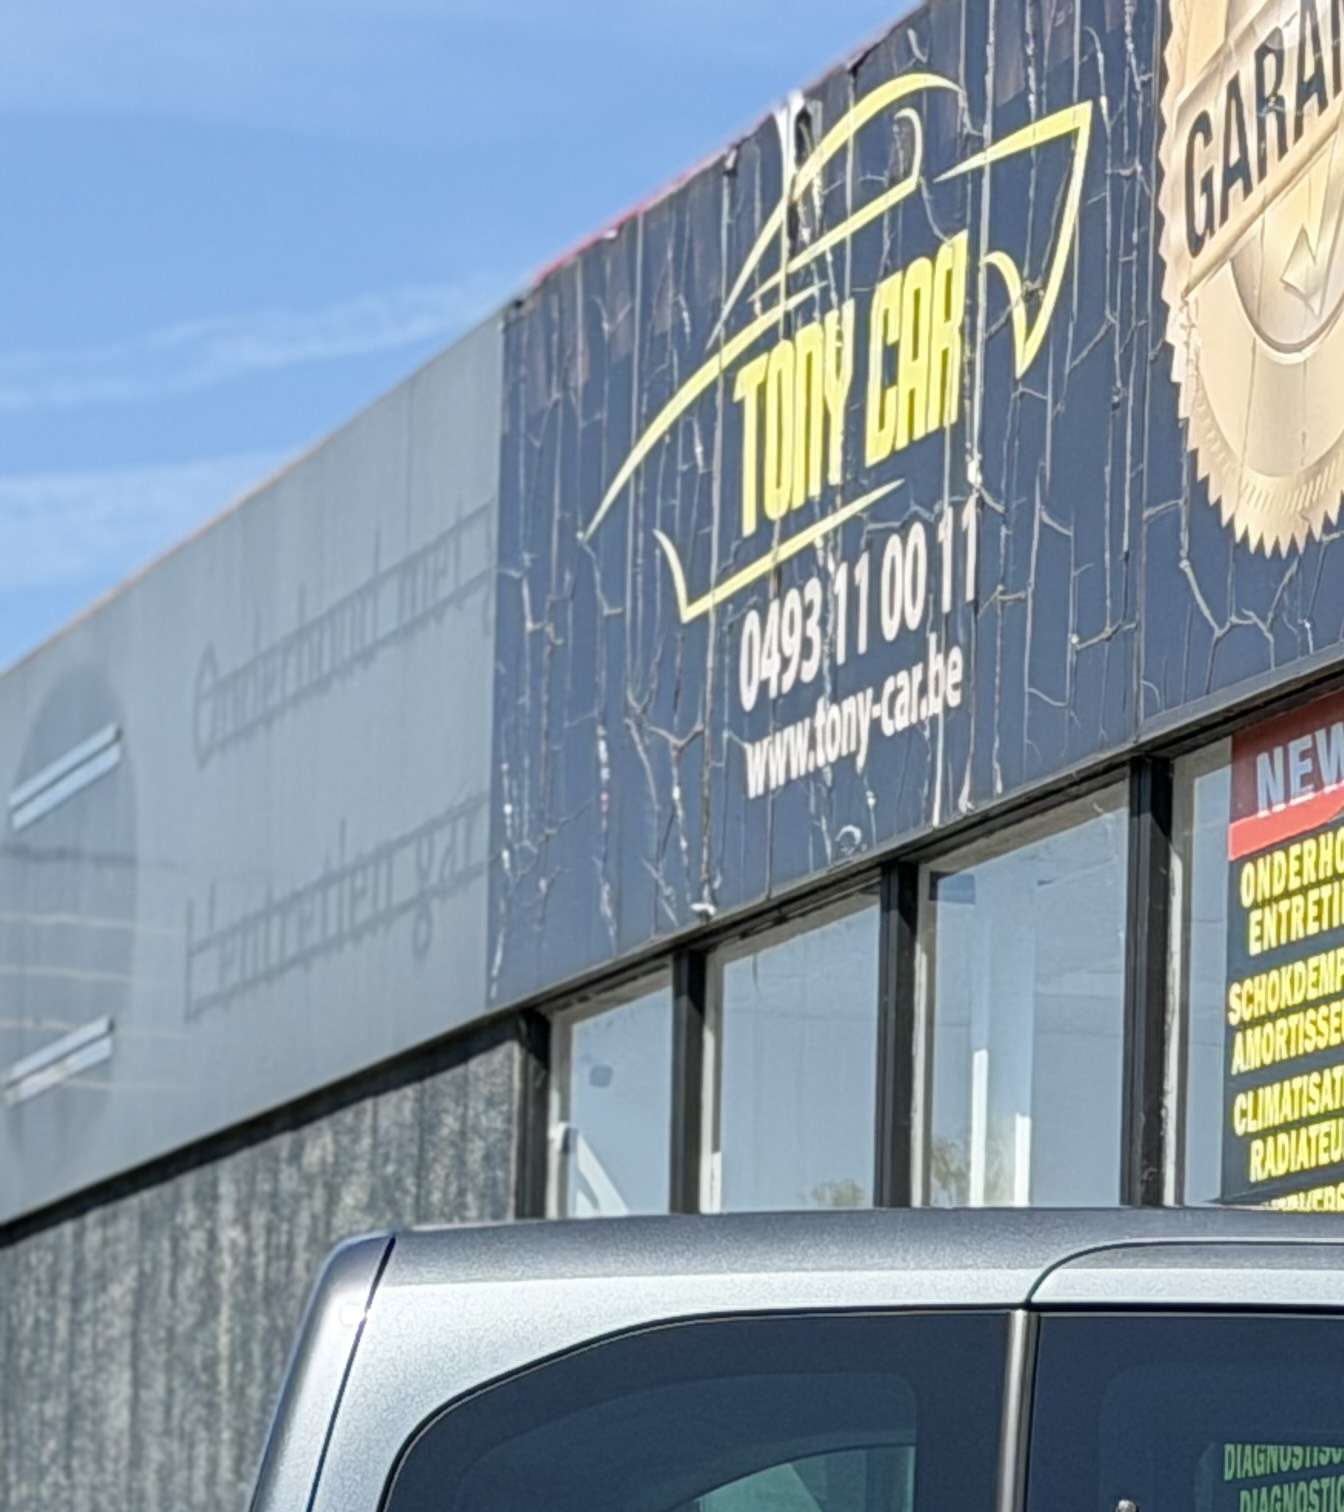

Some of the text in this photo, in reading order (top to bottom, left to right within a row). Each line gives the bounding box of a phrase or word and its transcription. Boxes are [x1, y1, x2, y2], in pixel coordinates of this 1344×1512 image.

[734, 229, 968, 537] TONY CAR
[739, 501, 980, 712] 0493 11 00 11
[744, 632, 963, 799] www.tony-car.be
